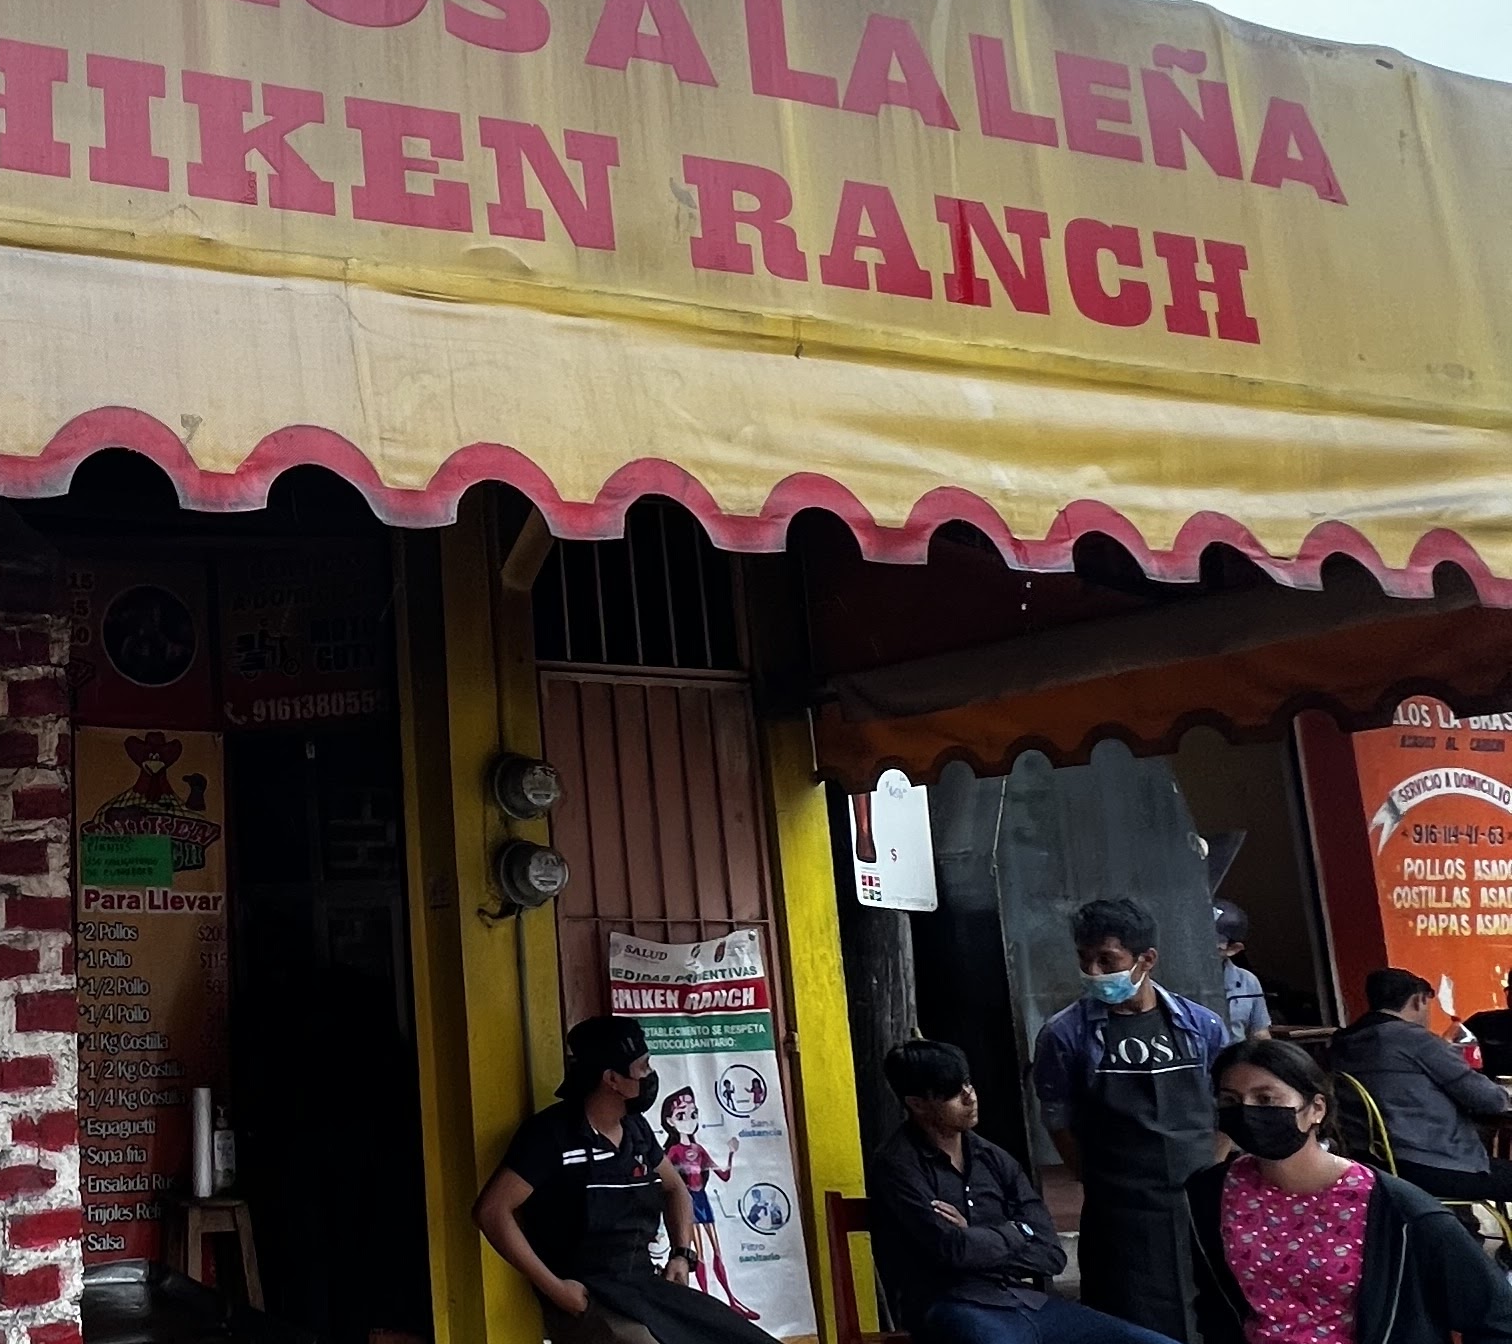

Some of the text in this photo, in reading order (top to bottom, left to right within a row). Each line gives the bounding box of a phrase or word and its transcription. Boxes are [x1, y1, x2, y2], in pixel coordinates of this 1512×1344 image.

[969, 32, 1349, 207] LEÑA
[682, 153, 1261, 345] RANCH
[252, 689, 384, 721] 916138055
[1398, 772, 1511, 805] SERVICIO A DOMICILIO
[1403, 858, 1467, 881] POLLOS
[84, 888, 223, 911] Para Llevar
[1393, 886, 1472, 909] COSTILLAS
[98, 922, 139, 941] Pollos
[1416, 914, 1512, 936] PAPAS ASAD
[99, 949, 132, 968] Pollo
[624, 944, 668, 961] SALUD
[87, 976, 150, 999] 1/2 Pollo
[684, 987, 755, 1010] RANCH
[87, 1004, 151, 1027] 1/4 Pollo
[643, 1024, 766, 1037] STABLECIMIENTO SE RESPETA
[100, 1032, 119, 1054] Kg
[120, 1031, 169, 1051] Costilla
[87, 1060, 115, 1083] 1/2
[117, 1060, 137, 1082] Kg
[87, 1088, 115, 1110] 1/4
[118, 1088, 137, 1110] Kg
[87, 1146, 123, 1167] Sopa
[88, 1173, 149, 1193] Ensalada
[88, 1202, 133, 1227] Frijoles
[88, 1232, 125, 1252] Salsa
